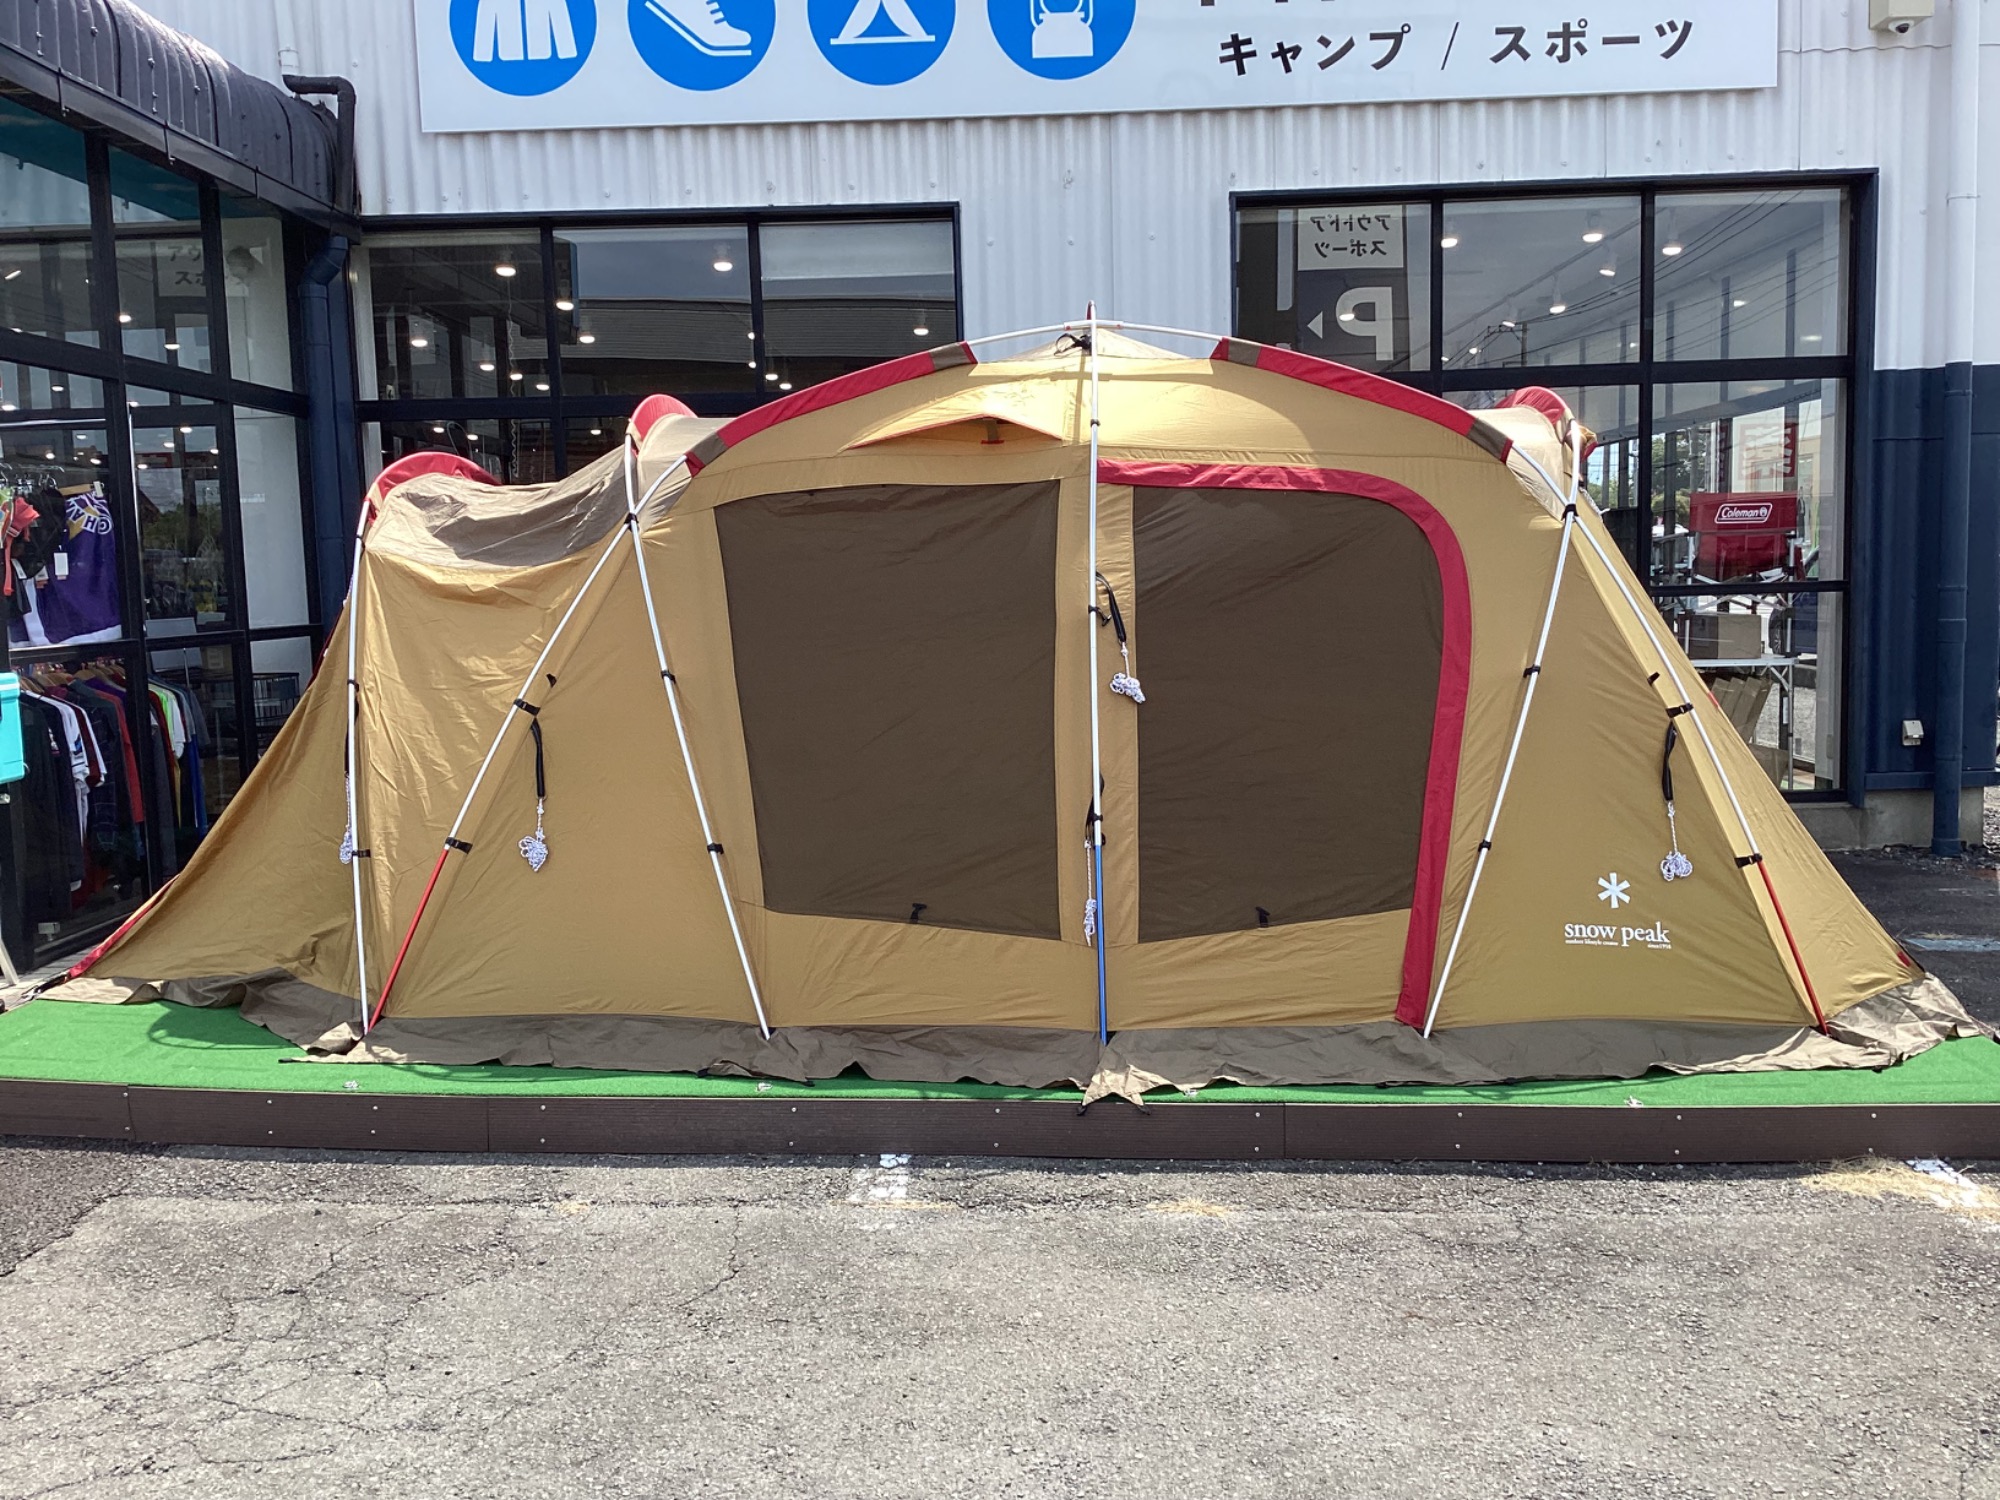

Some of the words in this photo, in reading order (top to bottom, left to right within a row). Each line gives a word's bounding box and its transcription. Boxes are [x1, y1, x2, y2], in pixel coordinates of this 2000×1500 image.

[1219, 23, 1412, 76] キャンプ
[1489, 18, 1694, 63] スポーツ
[1721, 506, 1759, 518] Coleman
[1564, 923, 1617, 939] snow
[1620, 920, 1671, 947] peak
